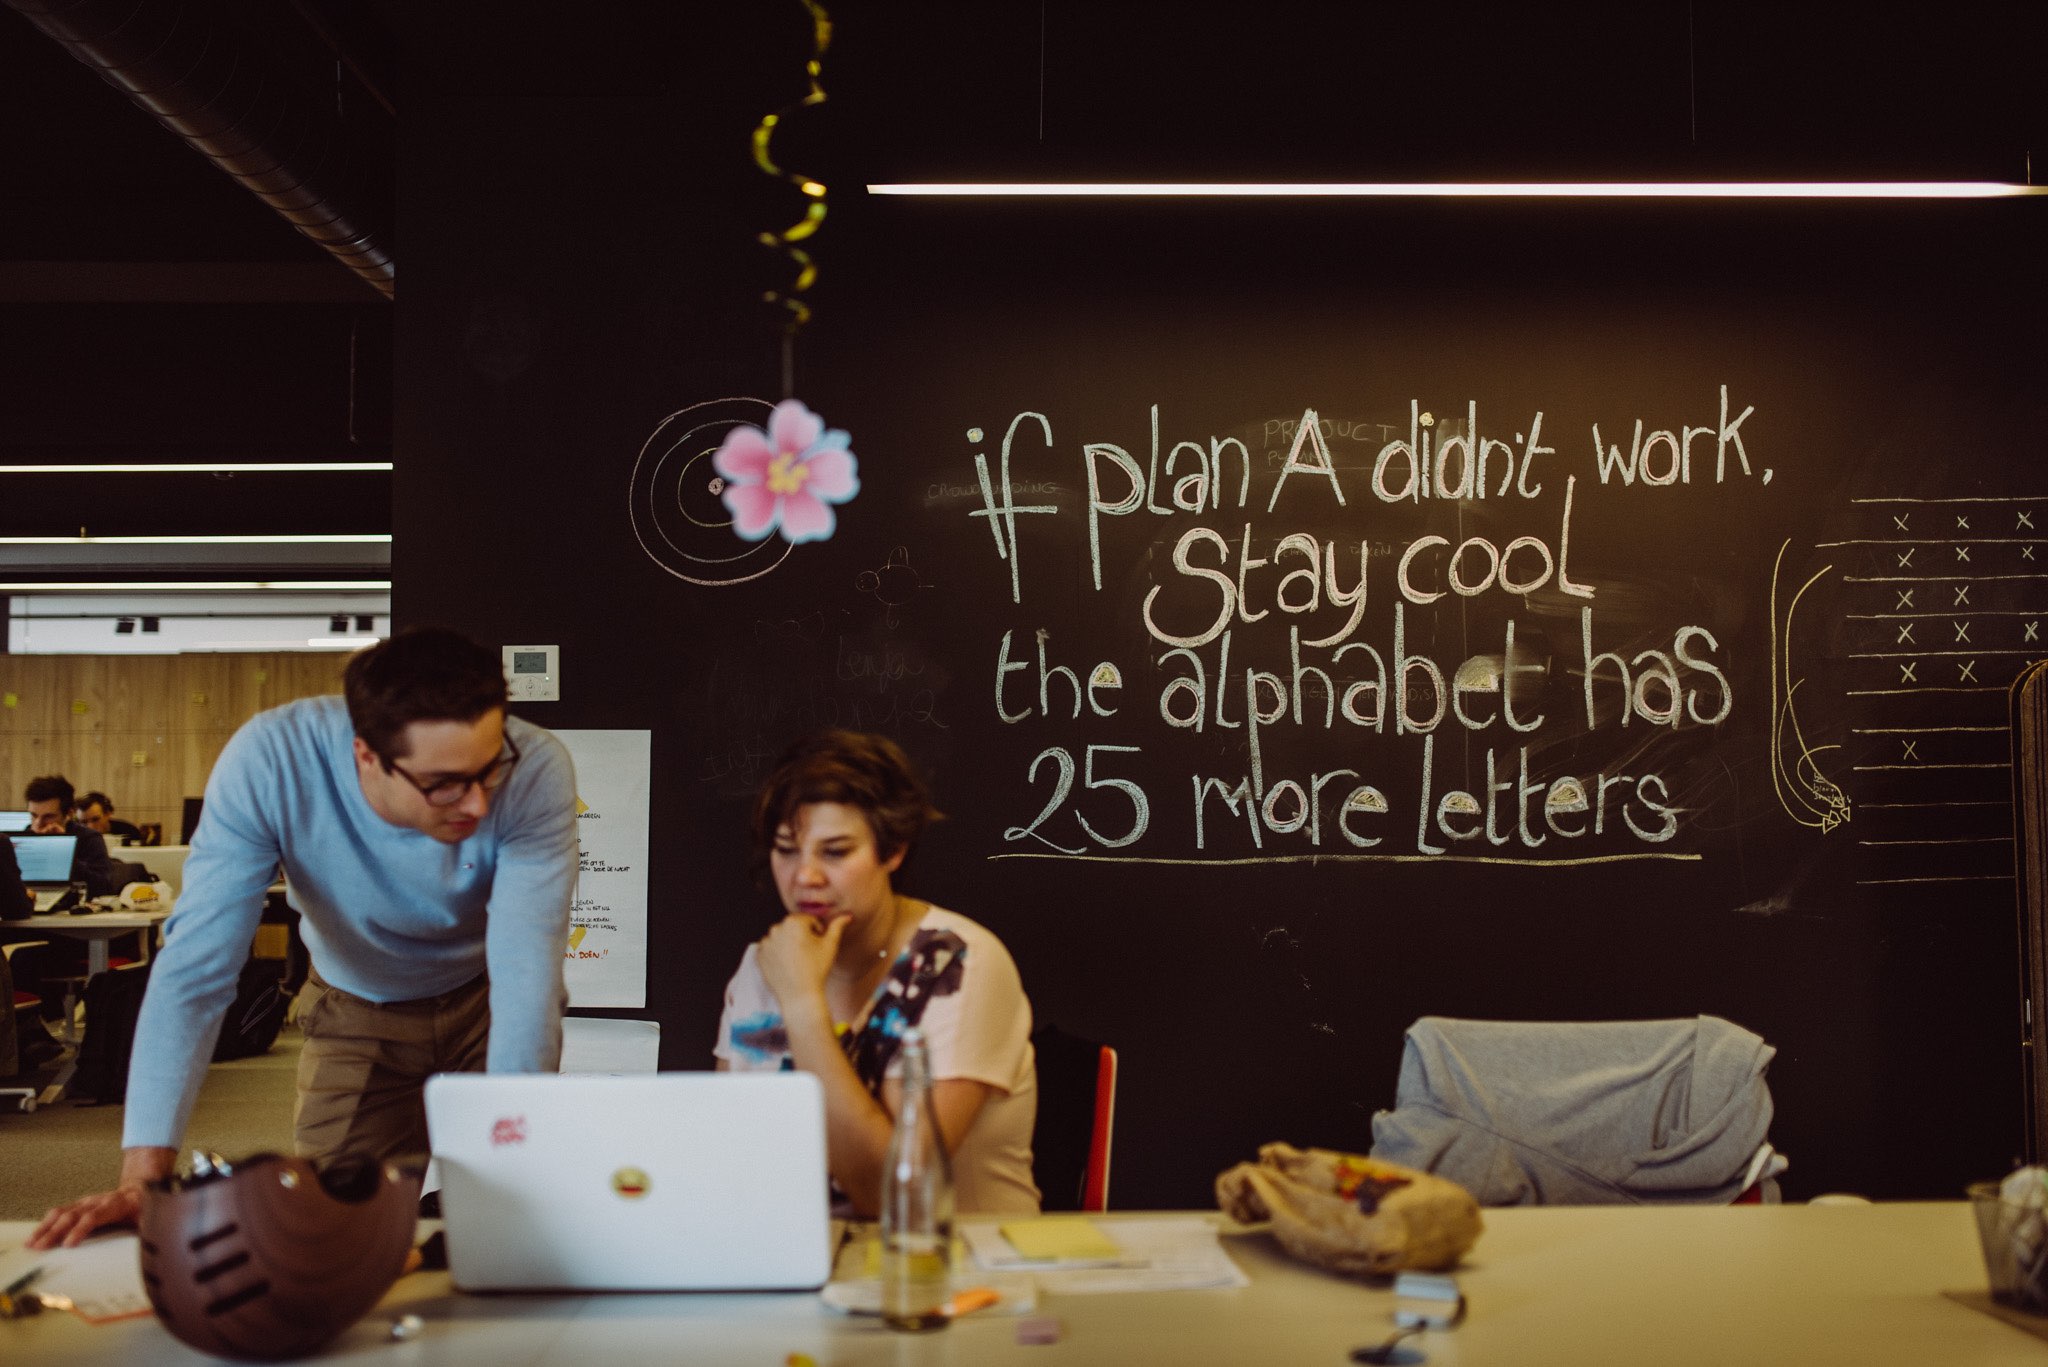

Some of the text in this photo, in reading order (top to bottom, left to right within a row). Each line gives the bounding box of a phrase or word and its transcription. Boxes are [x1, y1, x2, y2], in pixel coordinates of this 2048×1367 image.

[967, 411, 1058, 603] if
[1083, 404, 1250, 590] plan
[1268, 408, 1346, 512] A
[1592, 384, 1773, 486] work,
[1143, 522, 1368, 648] Stay
[995, 601, 1732, 800] the alphabet has
[1002, 743, 1151, 855] 25
[1418, 734, 1678, 856] letters
